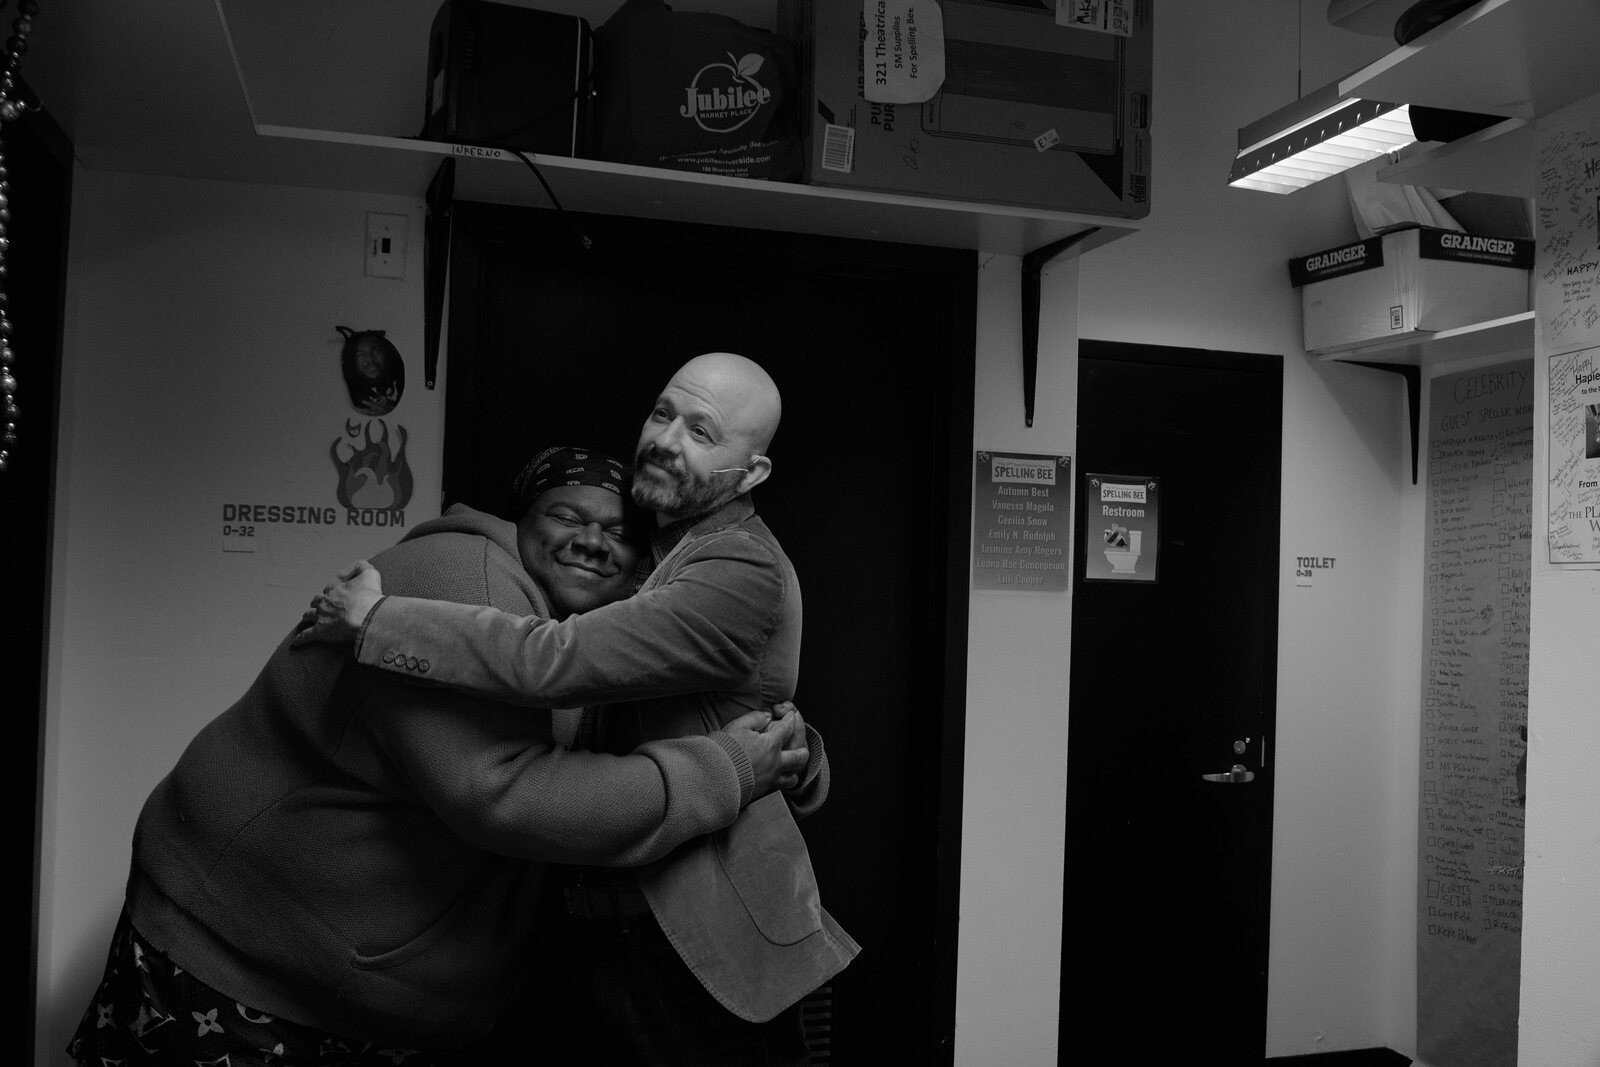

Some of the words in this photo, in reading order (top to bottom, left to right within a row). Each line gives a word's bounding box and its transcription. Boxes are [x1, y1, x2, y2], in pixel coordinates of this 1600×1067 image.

[907, 7, 916, 24] Bee
[876, 0, 886, 58] Theatrica
[893, 16, 903, 52] Supplies
[908, 26, 919, 61] Spelling
[895, 54, 903, 69] SM
[875, 61, 887, 86] 321
[910, 62, 918, 79] For
[680, 85, 771, 118] Jubilee
[730, 109, 753, 117] PLACE
[452, 145, 500, 158] INFERNO
[1441, 233, 1516, 256] GRAINGER
[1306, 244, 1366, 272] GRAINGER
[1567, 260, 1599, 276] HAPPY
[1454, 368, 1528, 404] CELEBRITY
[1589, 386, 1597, 394] the
[1441, 409, 1473, 432] GUEST
[994, 465, 1035, 479] SPELLING
[1037, 468, 1053, 480] BEE
[998, 486, 1029, 497] Autumn
[1031, 487, 1049, 497] Best
[1579, 480, 1599, 488] From
[1102, 489, 1132, 499] SPELLING
[1133, 491, 1145, 500] BEE
[992, 499, 1024, 511] Vanessa
[1026, 501, 1054, 513] Magula
[1102, 505, 1145, 518] Restroom
[1569, 511, 1583, 519] THE
[1585, 506, 1600, 519] PL
[223, 504, 336, 525] DRESSING
[347, 509, 405, 527] ROOM
[1027, 516, 1048, 526] Snow
[223, 525, 255, 537] 0-32
[988, 530, 1010, 541] Emily
[1023, 530, 1056, 543] Rudolph
[1015, 545, 1032, 556] Amy
[1035, 546, 1063, 557] Rogers
[1296, 556, 1336, 569] TOILET
